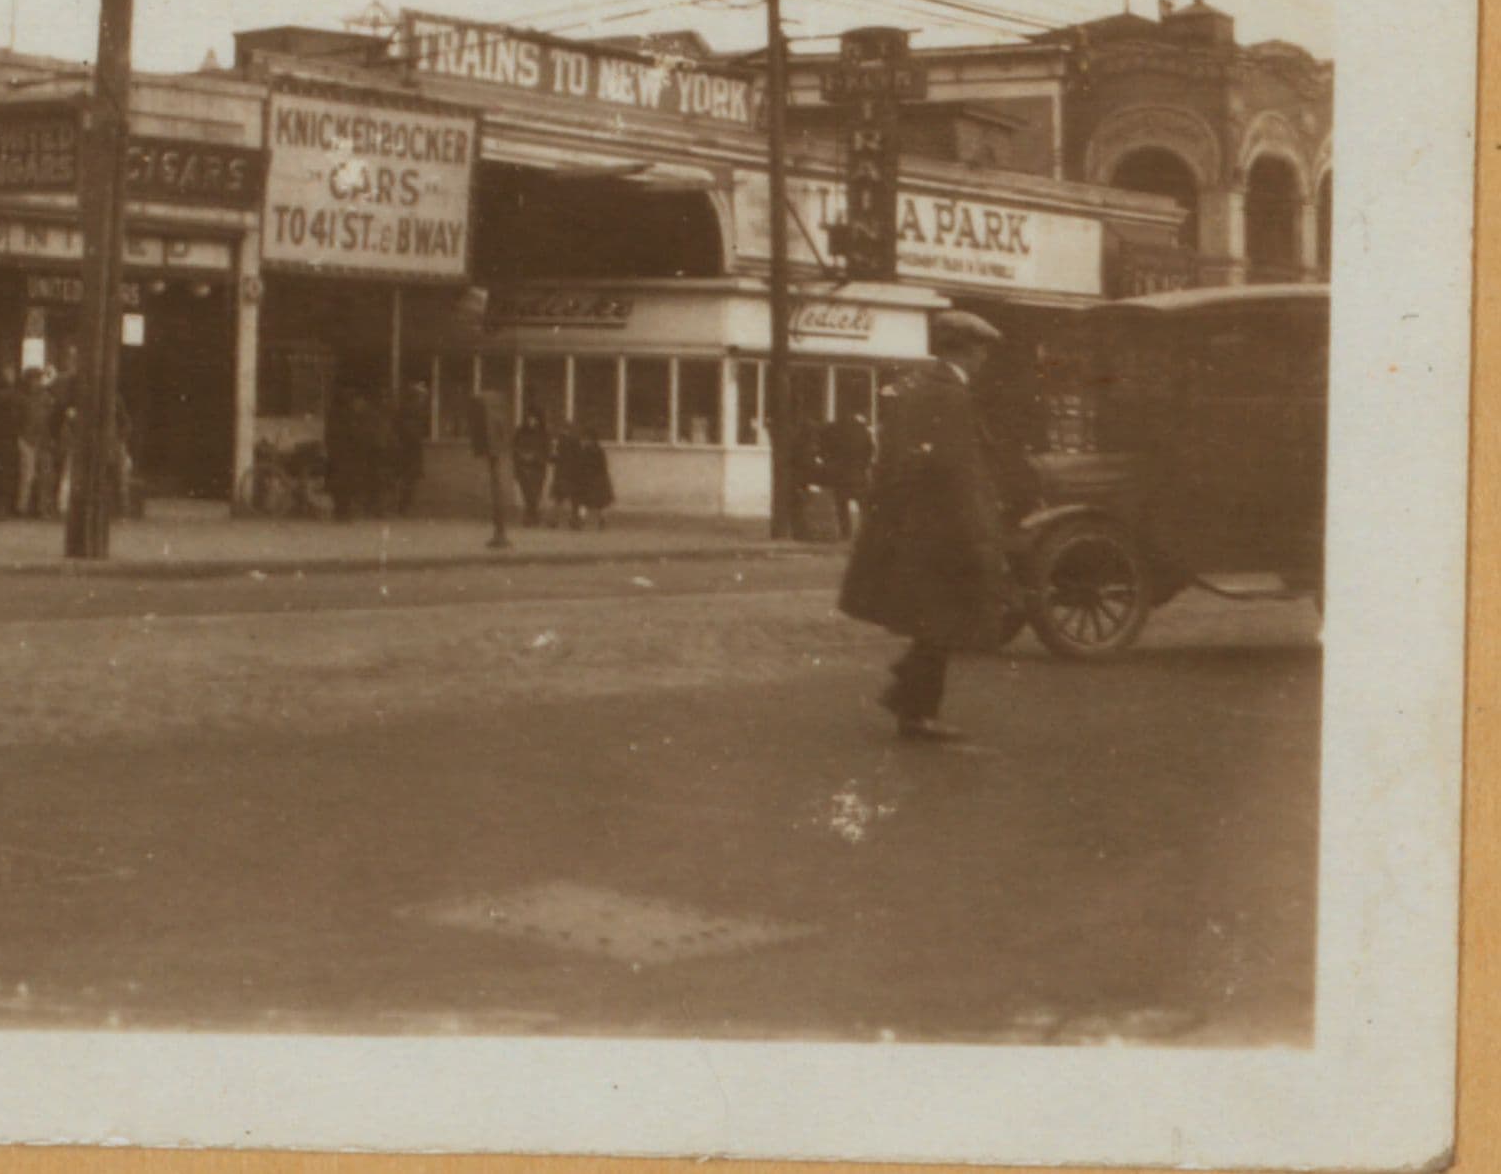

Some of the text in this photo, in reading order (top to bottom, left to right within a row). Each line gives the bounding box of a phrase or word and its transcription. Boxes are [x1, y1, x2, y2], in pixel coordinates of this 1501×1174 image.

[414, 20, 749, 123] TRAINS TO NEW YORK
[275, 106, 469, 166] KNICKERBOCKER
[126, 144, 249, 191] CIGARS
[328, 162, 420, 207] CARS
[273, 205, 307, 247] TO
[932, 199, 1031, 255] PARK
